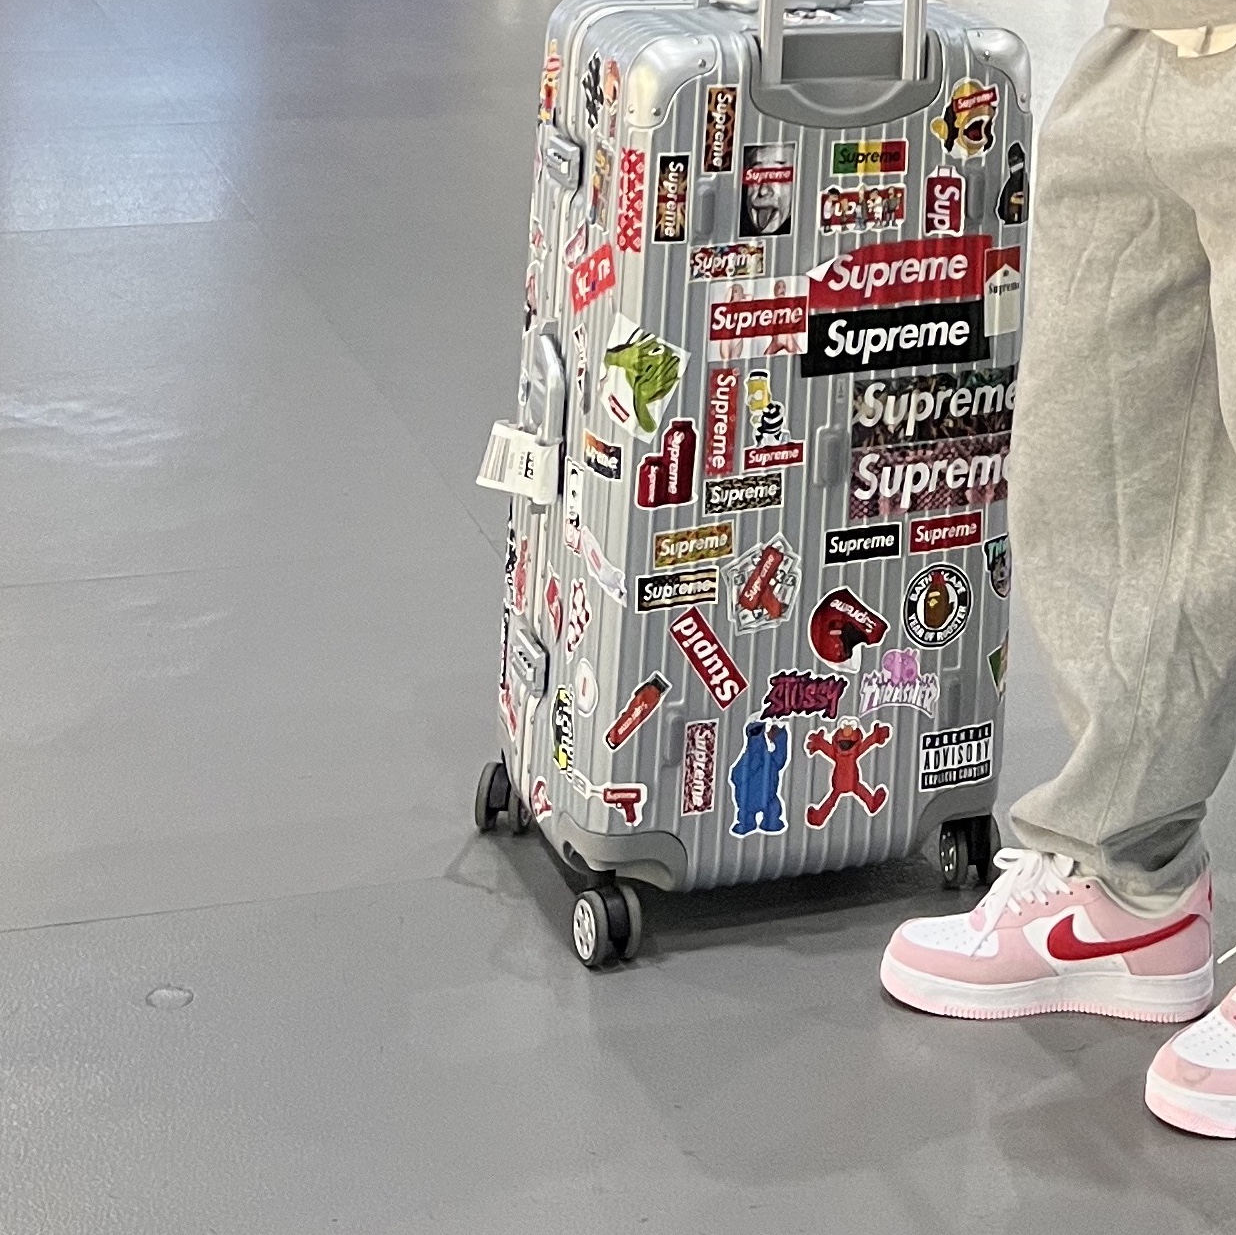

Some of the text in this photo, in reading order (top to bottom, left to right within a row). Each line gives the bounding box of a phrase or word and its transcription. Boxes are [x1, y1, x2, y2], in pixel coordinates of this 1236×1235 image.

[711, 92, 733, 168] Supreme
[839, 147, 901, 167] Supreme
[745, 169, 791, 183] Supreme
[664, 160, 684, 238] Supreme
[927, 184, 960, 230] Sup
[827, 253, 969, 298] Supreme
[712, 304, 803, 335] Supreme
[824, 318, 970, 365] Supreme
[711, 373, 737, 469] Supreme
[667, 431, 685, 495] Supreme
[749, 447, 800, 466] Supreme
[710, 483, 779, 507] Supreme
[854, 453, 1010, 509] Suprem
[660, 532, 728, 559] Supreme
[829, 533, 894, 554] Supreme
[915, 521, 977, 545] Supreme
[643, 578, 712, 603] Supreme
[744, 554, 775, 602] Supeme
[908, 613, 924, 638] YEAR
[672, 616, 740, 702] Stupid
[924, 739, 990, 771] ADVISORY
